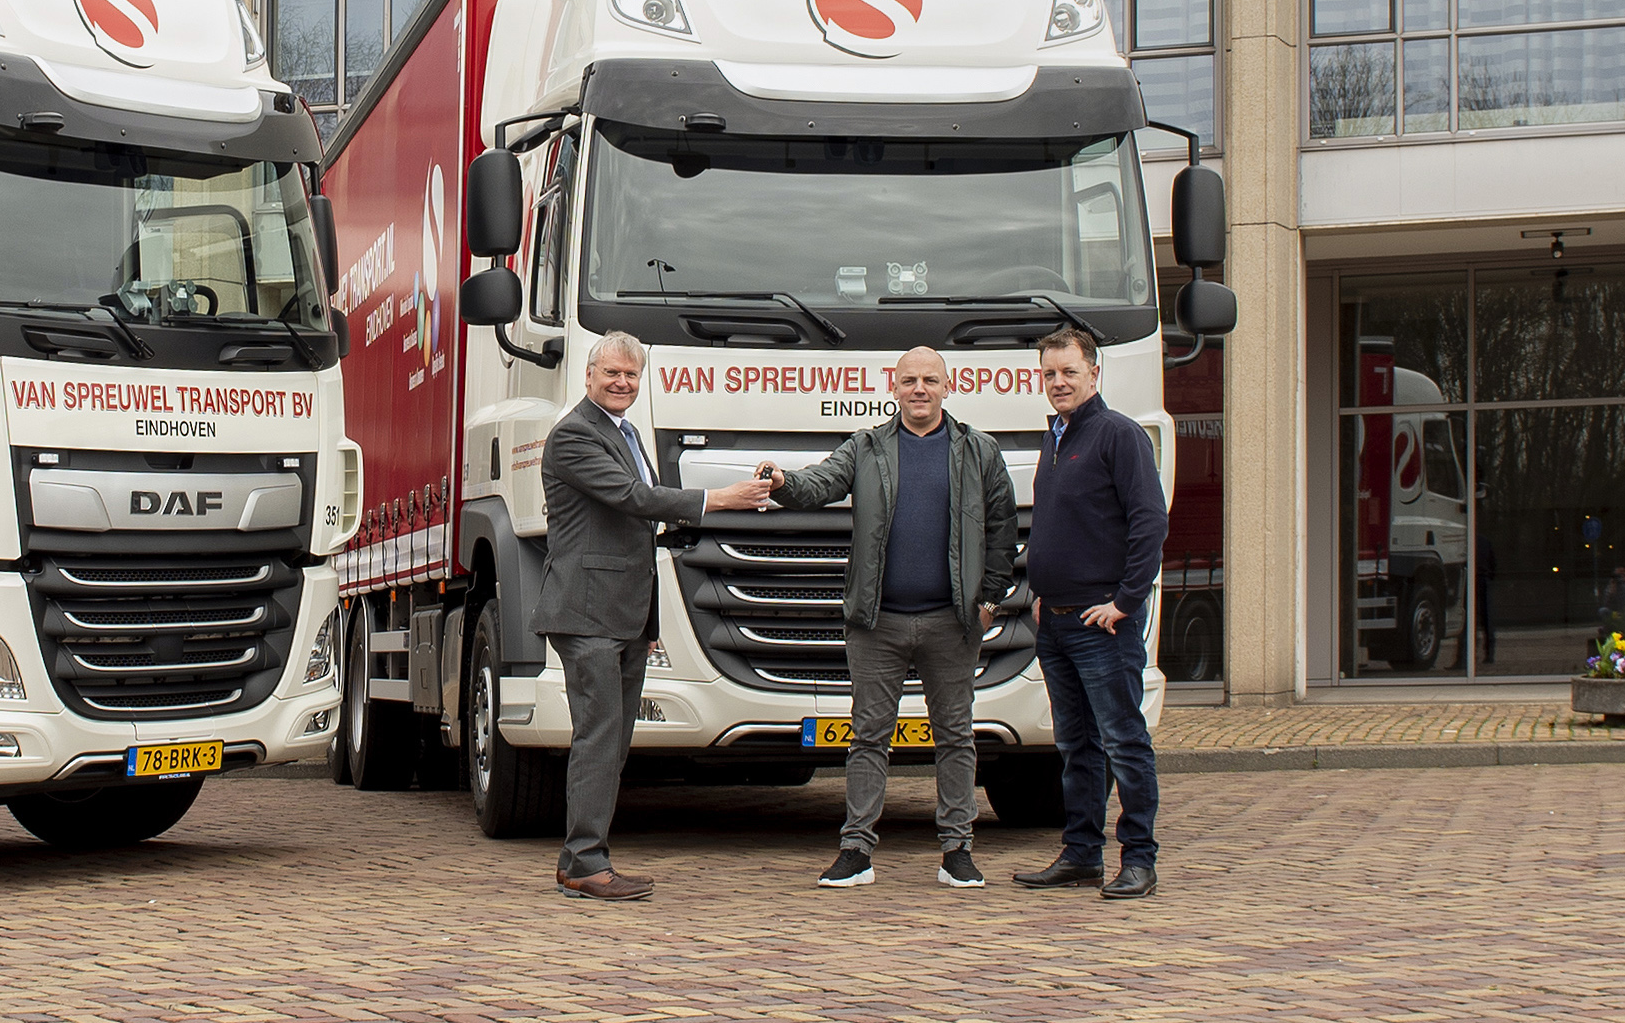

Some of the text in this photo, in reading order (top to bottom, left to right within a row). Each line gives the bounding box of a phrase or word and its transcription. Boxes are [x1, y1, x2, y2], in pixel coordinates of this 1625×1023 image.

[659, 366, 1044, 396] VAN SPREUWEL TNSPORT
[10, 380, 314, 419] VAN SPREUWEL TRANSPORT BV
[820, 400, 901, 418] EINDHO
[136, 419, 217, 439] EINDHOVEN
[129, 490, 223, 516] DAF
[142, 745, 217, 772] 78-BRK-3
